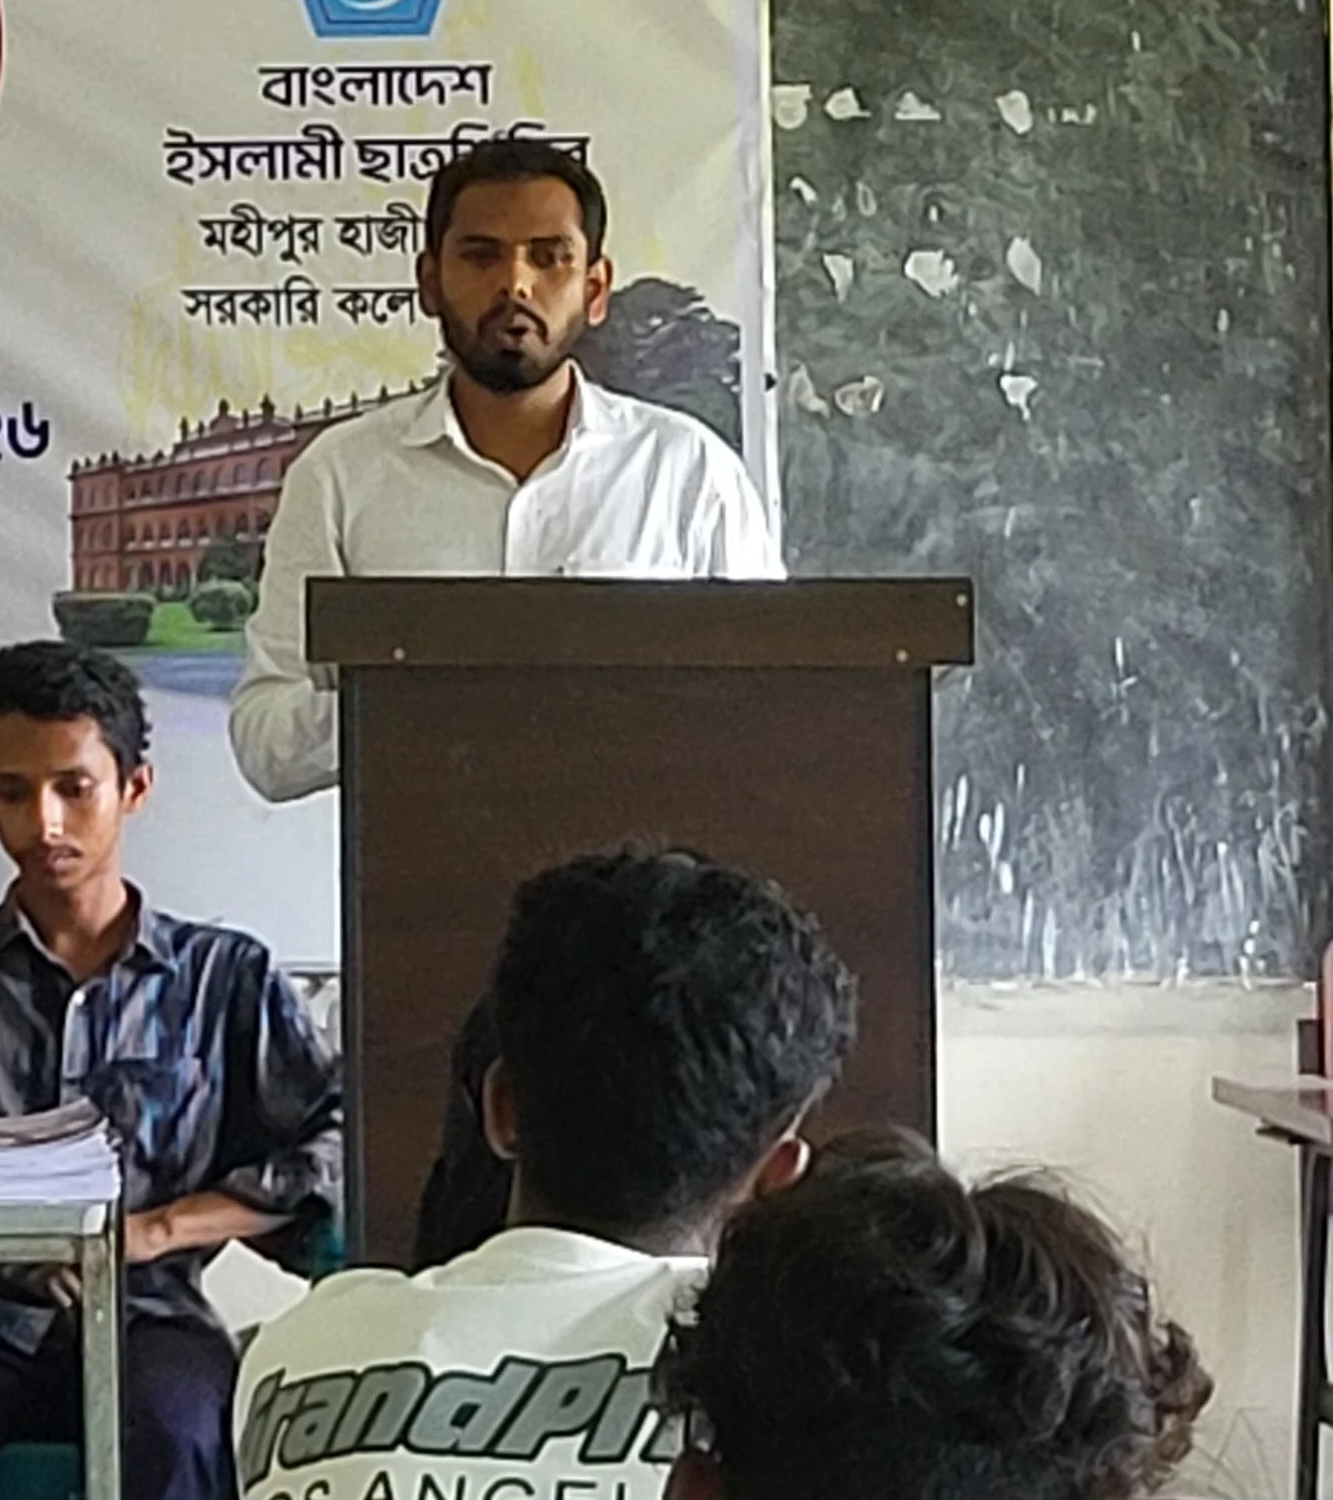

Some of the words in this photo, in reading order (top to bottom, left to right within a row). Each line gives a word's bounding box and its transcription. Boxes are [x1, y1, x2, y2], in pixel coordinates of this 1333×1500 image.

[259, 66, 491, 106] বাংলাদেশ
[164, 127, 343, 184] ইসলামী
[198, 203, 323, 264] মহীপুর
[334, 204, 425, 255] হাজী
[181, 275, 321, 328] সরকারি
[331, 290, 417, 326] কলে
